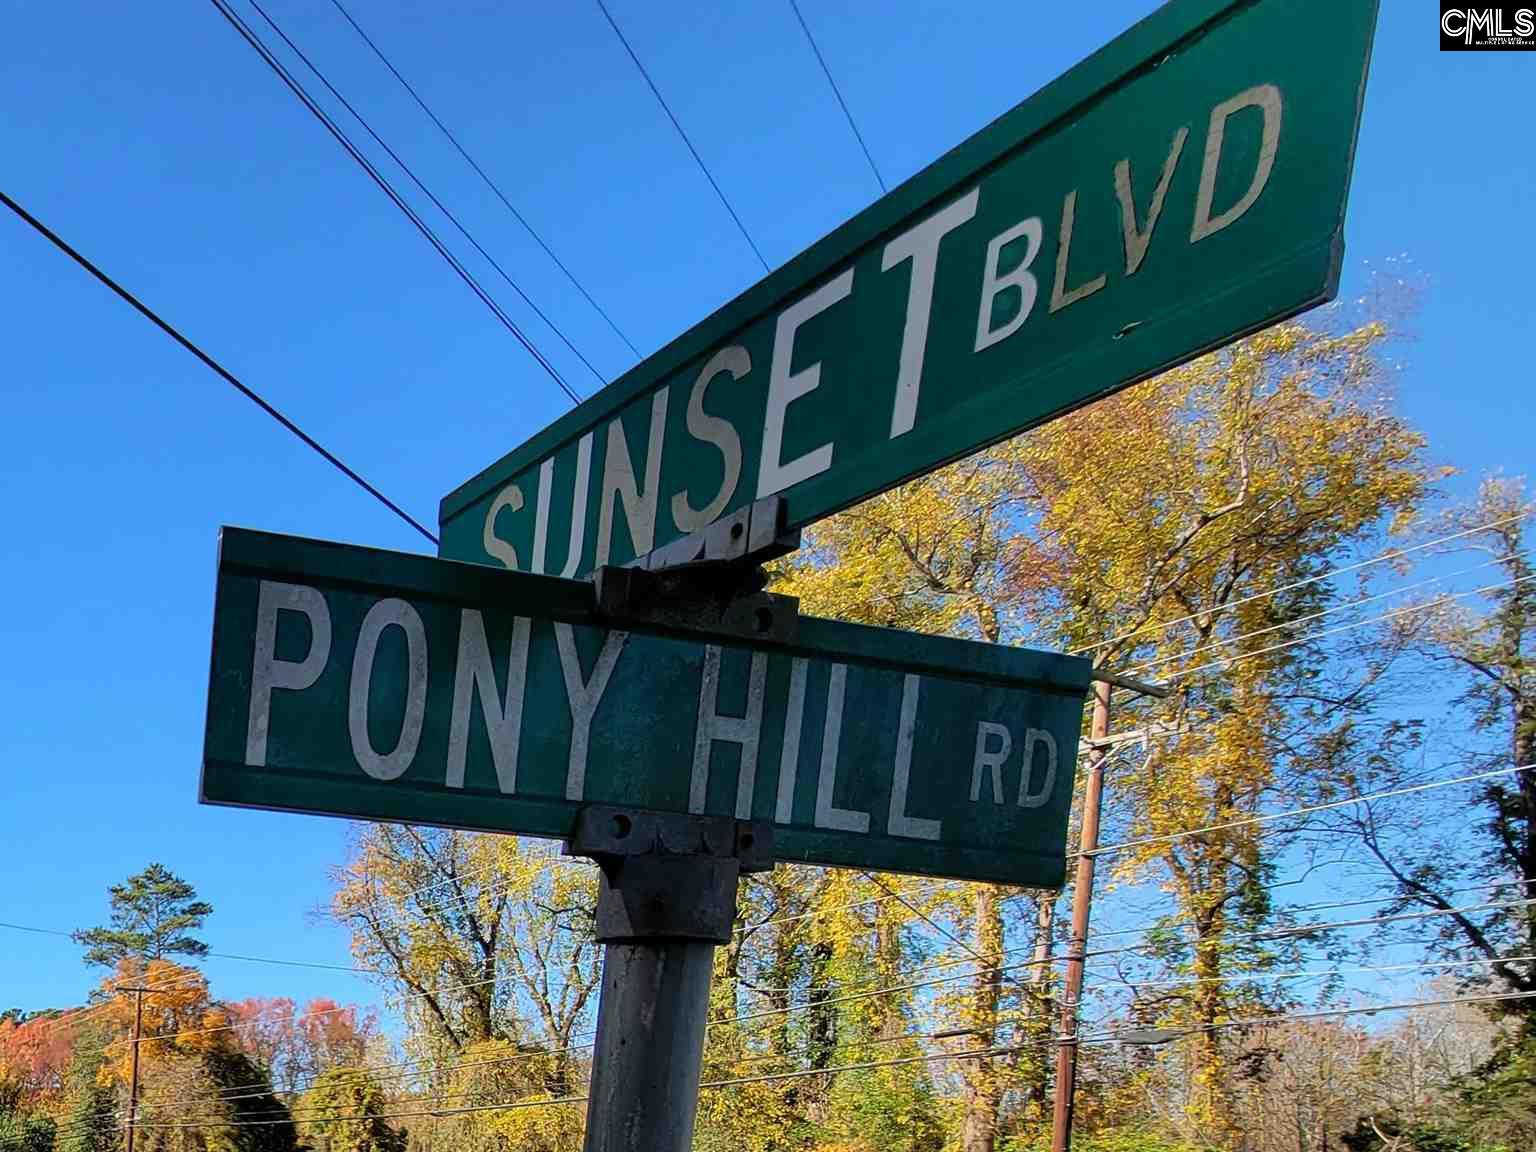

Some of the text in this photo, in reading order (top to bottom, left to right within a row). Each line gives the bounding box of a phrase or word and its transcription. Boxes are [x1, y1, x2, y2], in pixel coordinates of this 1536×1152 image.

[483, 83, 1284, 579] SUNSET BLVD
[245, 579, 1059, 841] PONY HILL RD
